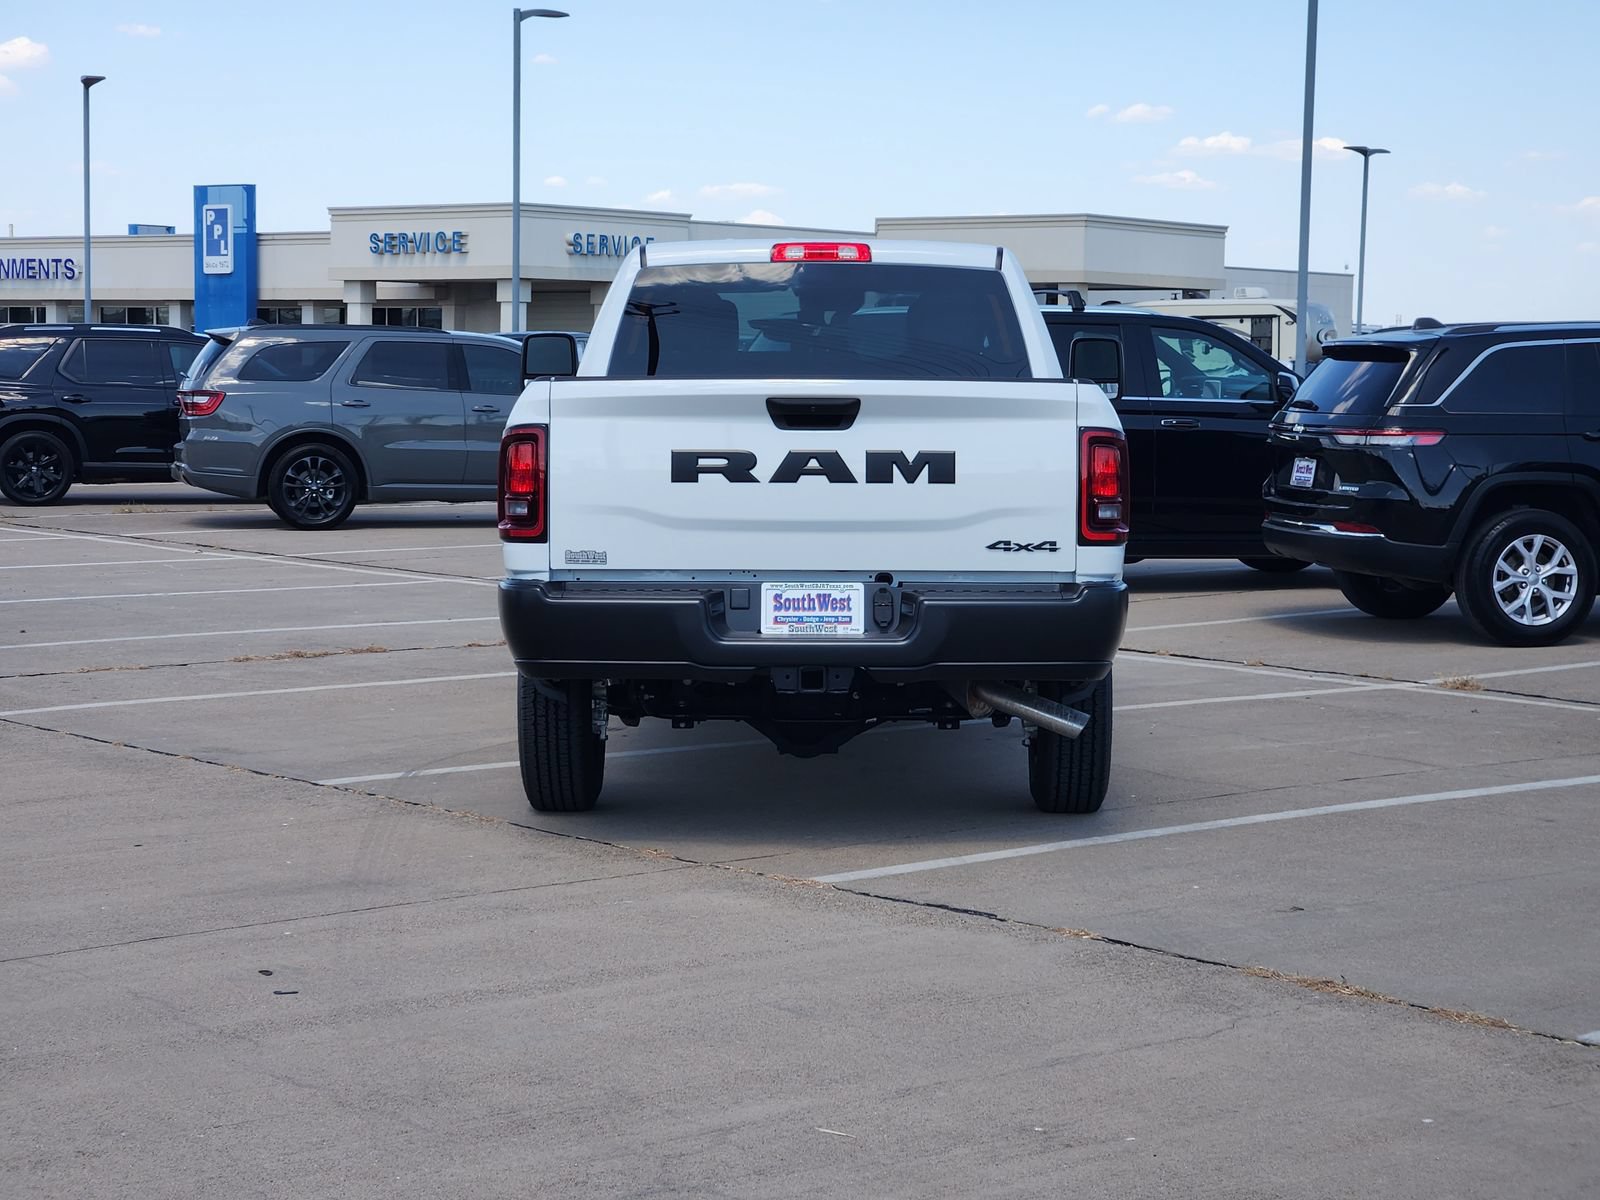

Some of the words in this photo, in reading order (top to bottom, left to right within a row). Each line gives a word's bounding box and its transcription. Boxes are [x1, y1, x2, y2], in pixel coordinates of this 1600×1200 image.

[369, 231, 466, 255] SERVICE
[573, 232, 655, 257] SERVIC
[0, 258, 77, 281] NMENTS
[671, 449, 956, 485] RAM
[985, 540, 1062, 553] 4x4
[772, 592, 852, 612] SouthWest
[788, 624, 838, 633] SouthWest
